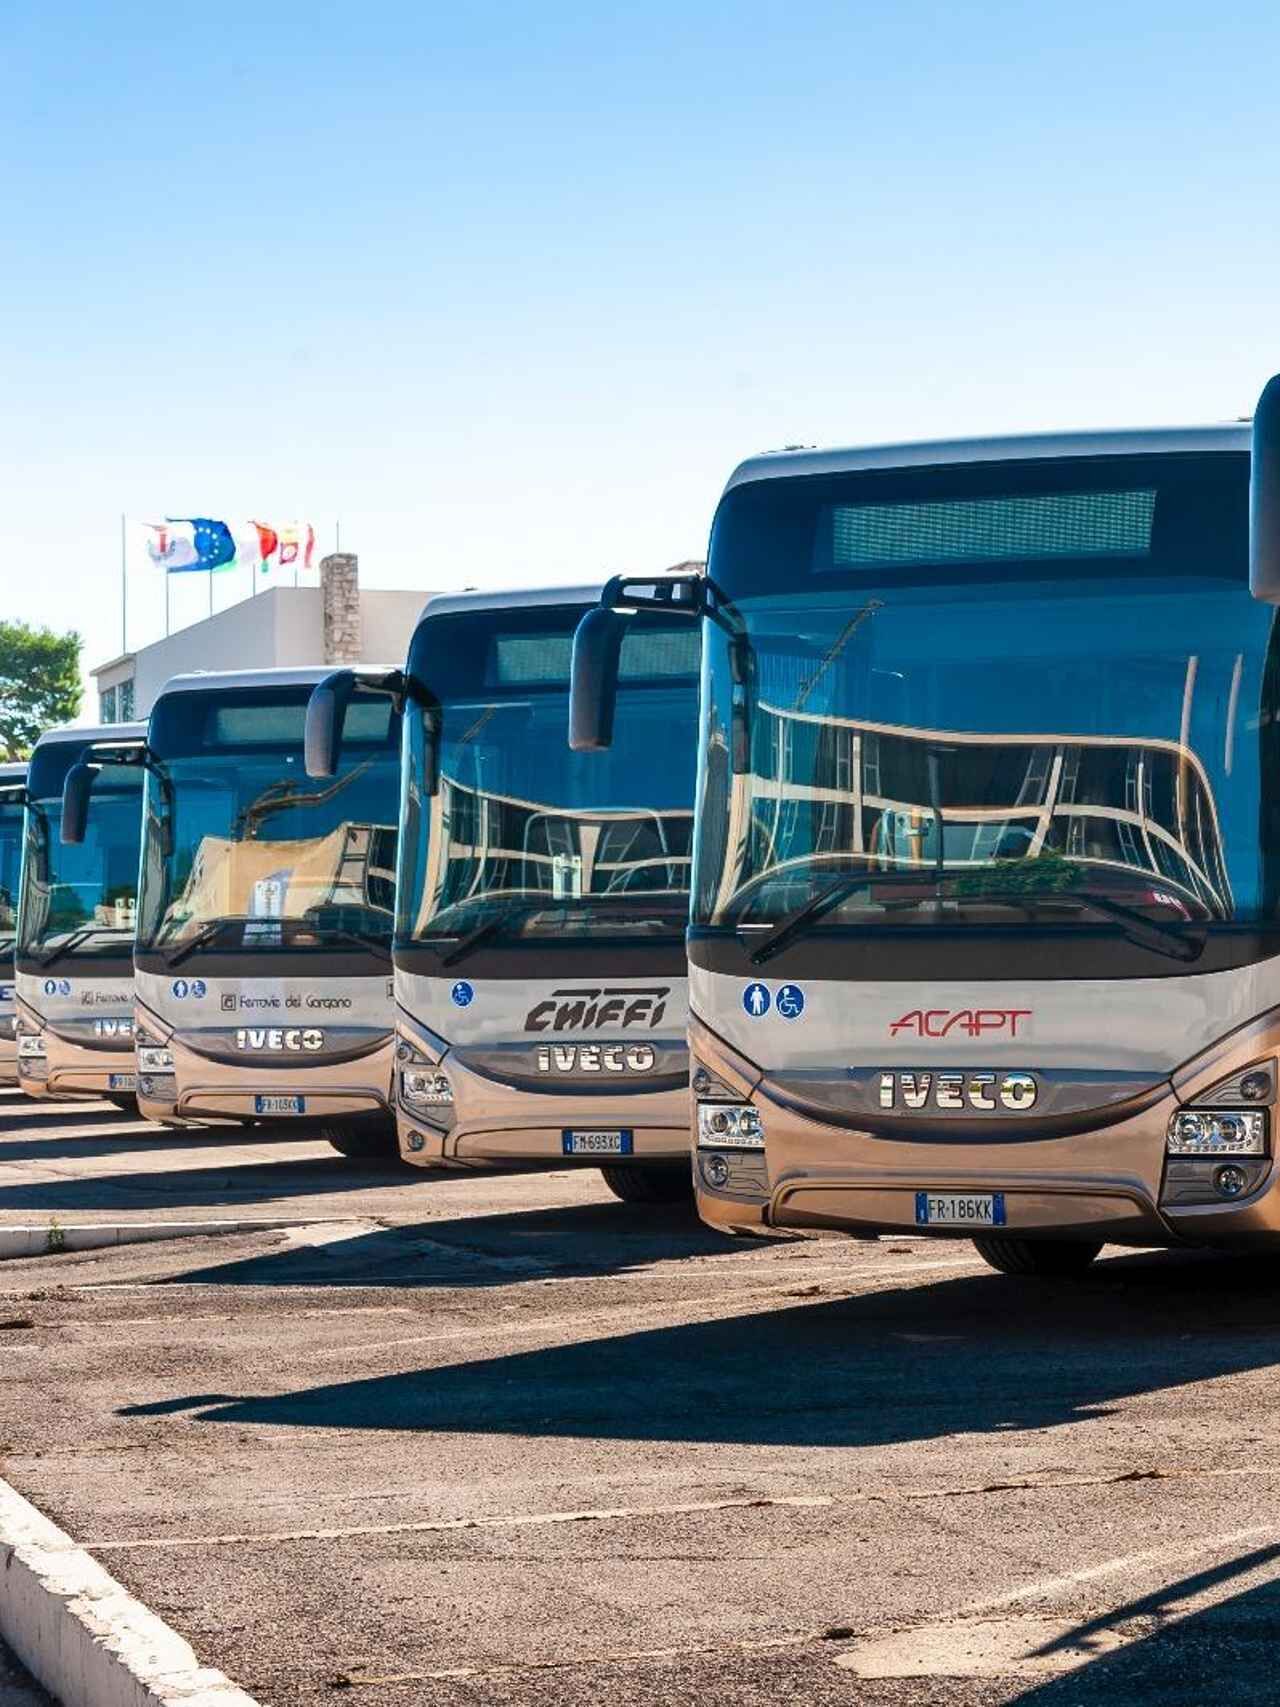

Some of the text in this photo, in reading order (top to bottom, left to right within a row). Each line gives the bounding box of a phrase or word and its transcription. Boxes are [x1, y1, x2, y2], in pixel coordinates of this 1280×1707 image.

[524, 987, 671, 1032] CHIFFI
[889, 1010, 1033, 1038] ACAPT
[236, 1028, 324, 1050] IVECO
[537, 1044, 656, 1073] IVECO
[879, 1072, 1039, 1110] IVECO
